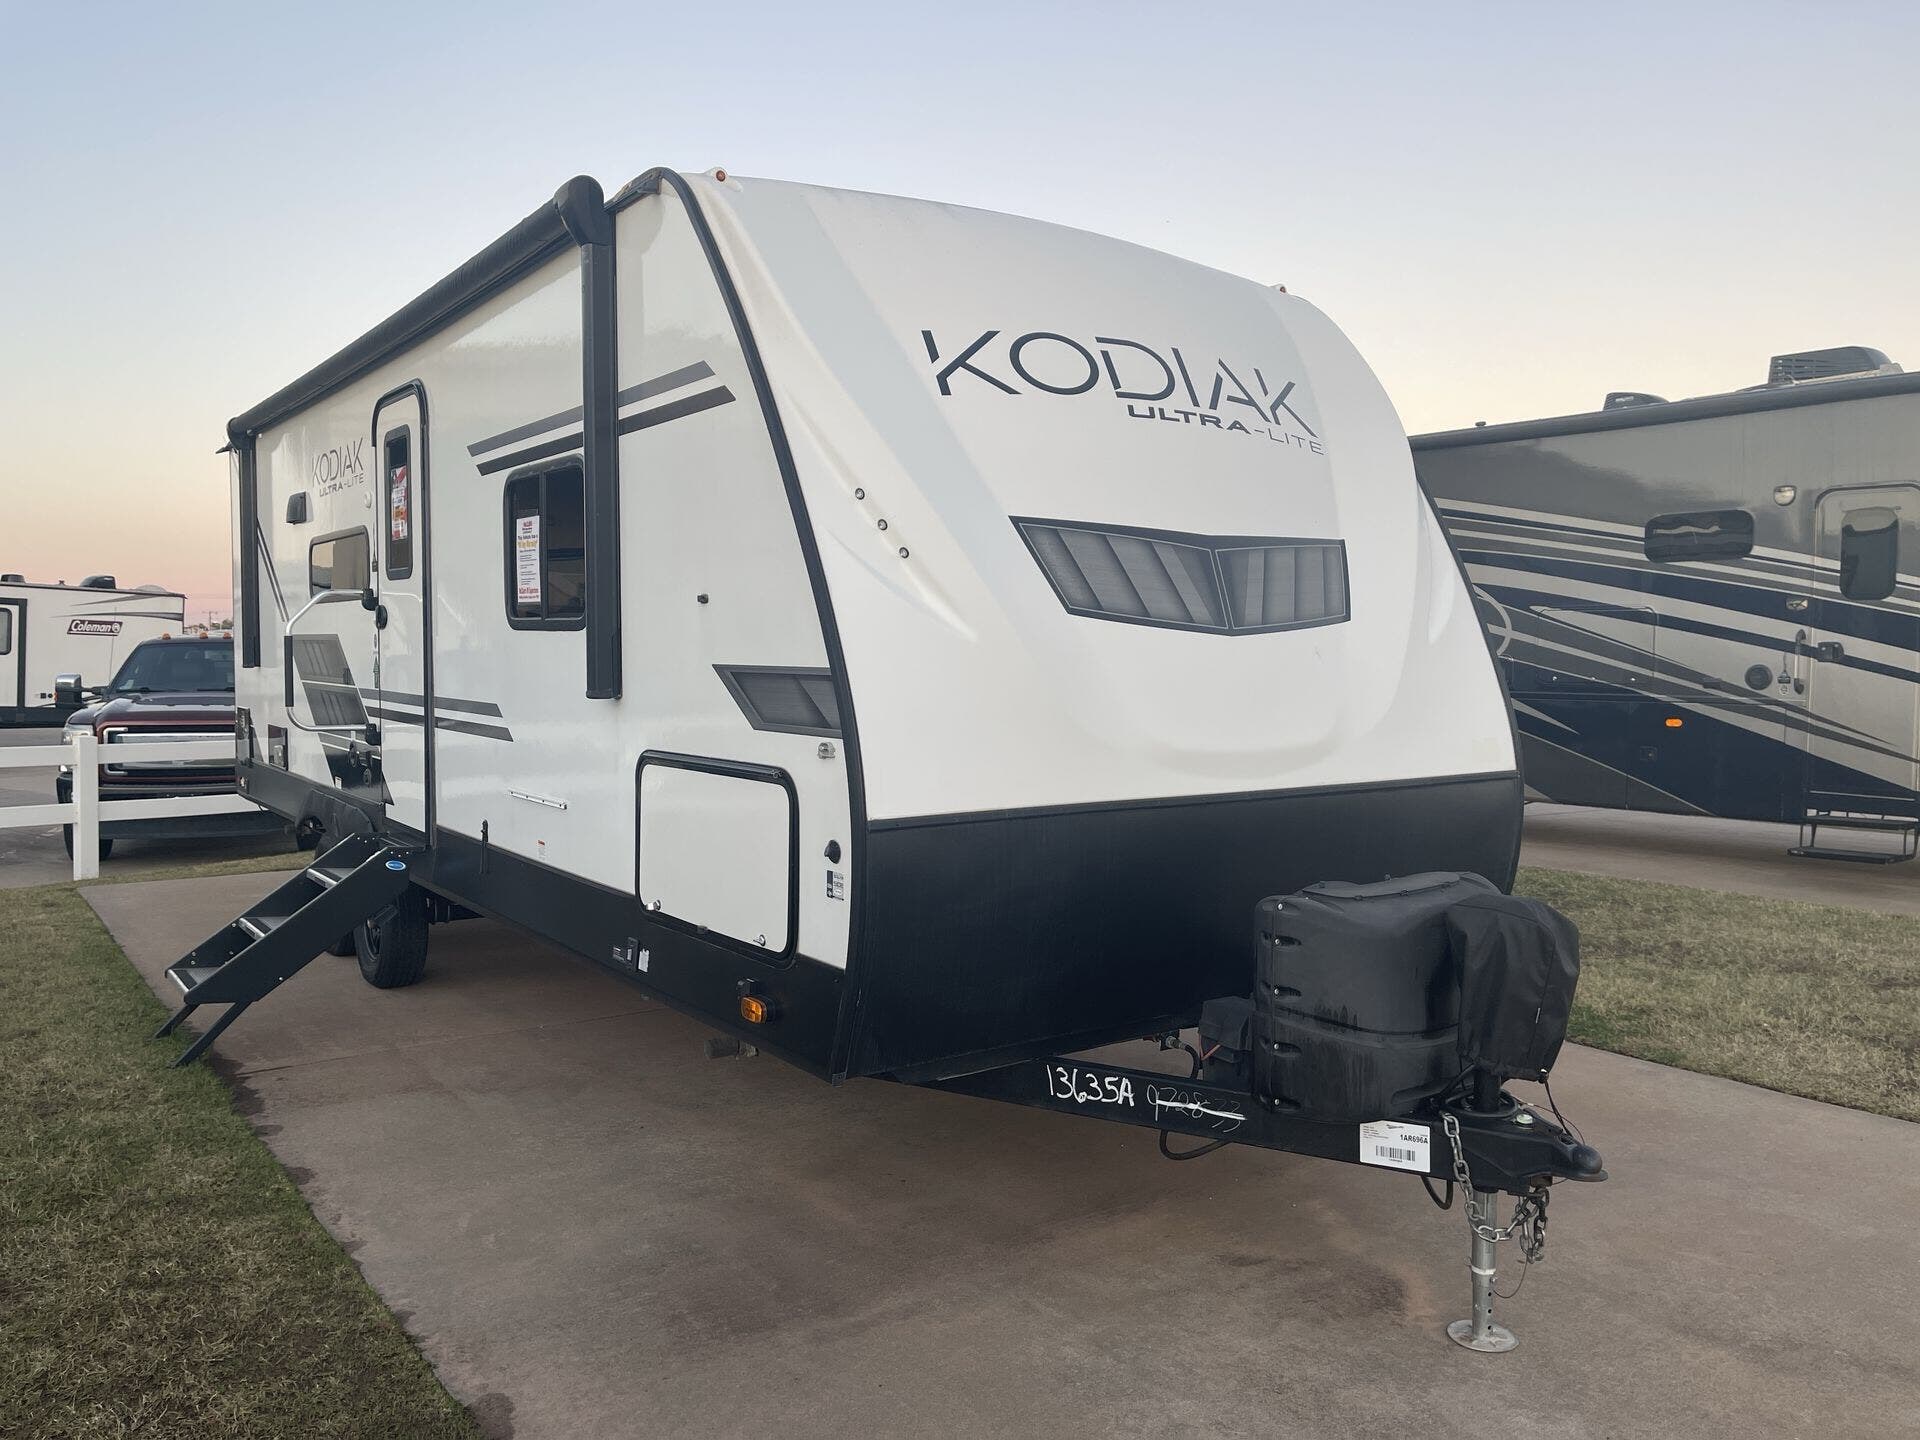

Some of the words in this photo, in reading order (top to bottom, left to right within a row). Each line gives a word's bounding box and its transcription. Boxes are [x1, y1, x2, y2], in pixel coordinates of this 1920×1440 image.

[921, 330, 1319, 438] KODIAK
[1127, 403, 1326, 456] ULTRA-LITE
[311, 437, 364, 487] KODIAK
[319, 473, 364, 497] ULTRA-LITE
[71, 620, 112, 632] Coleman
[1046, 1064, 1135, 1107] 13635A
[1400, 1134, 1429, 1144] 1AR696A
